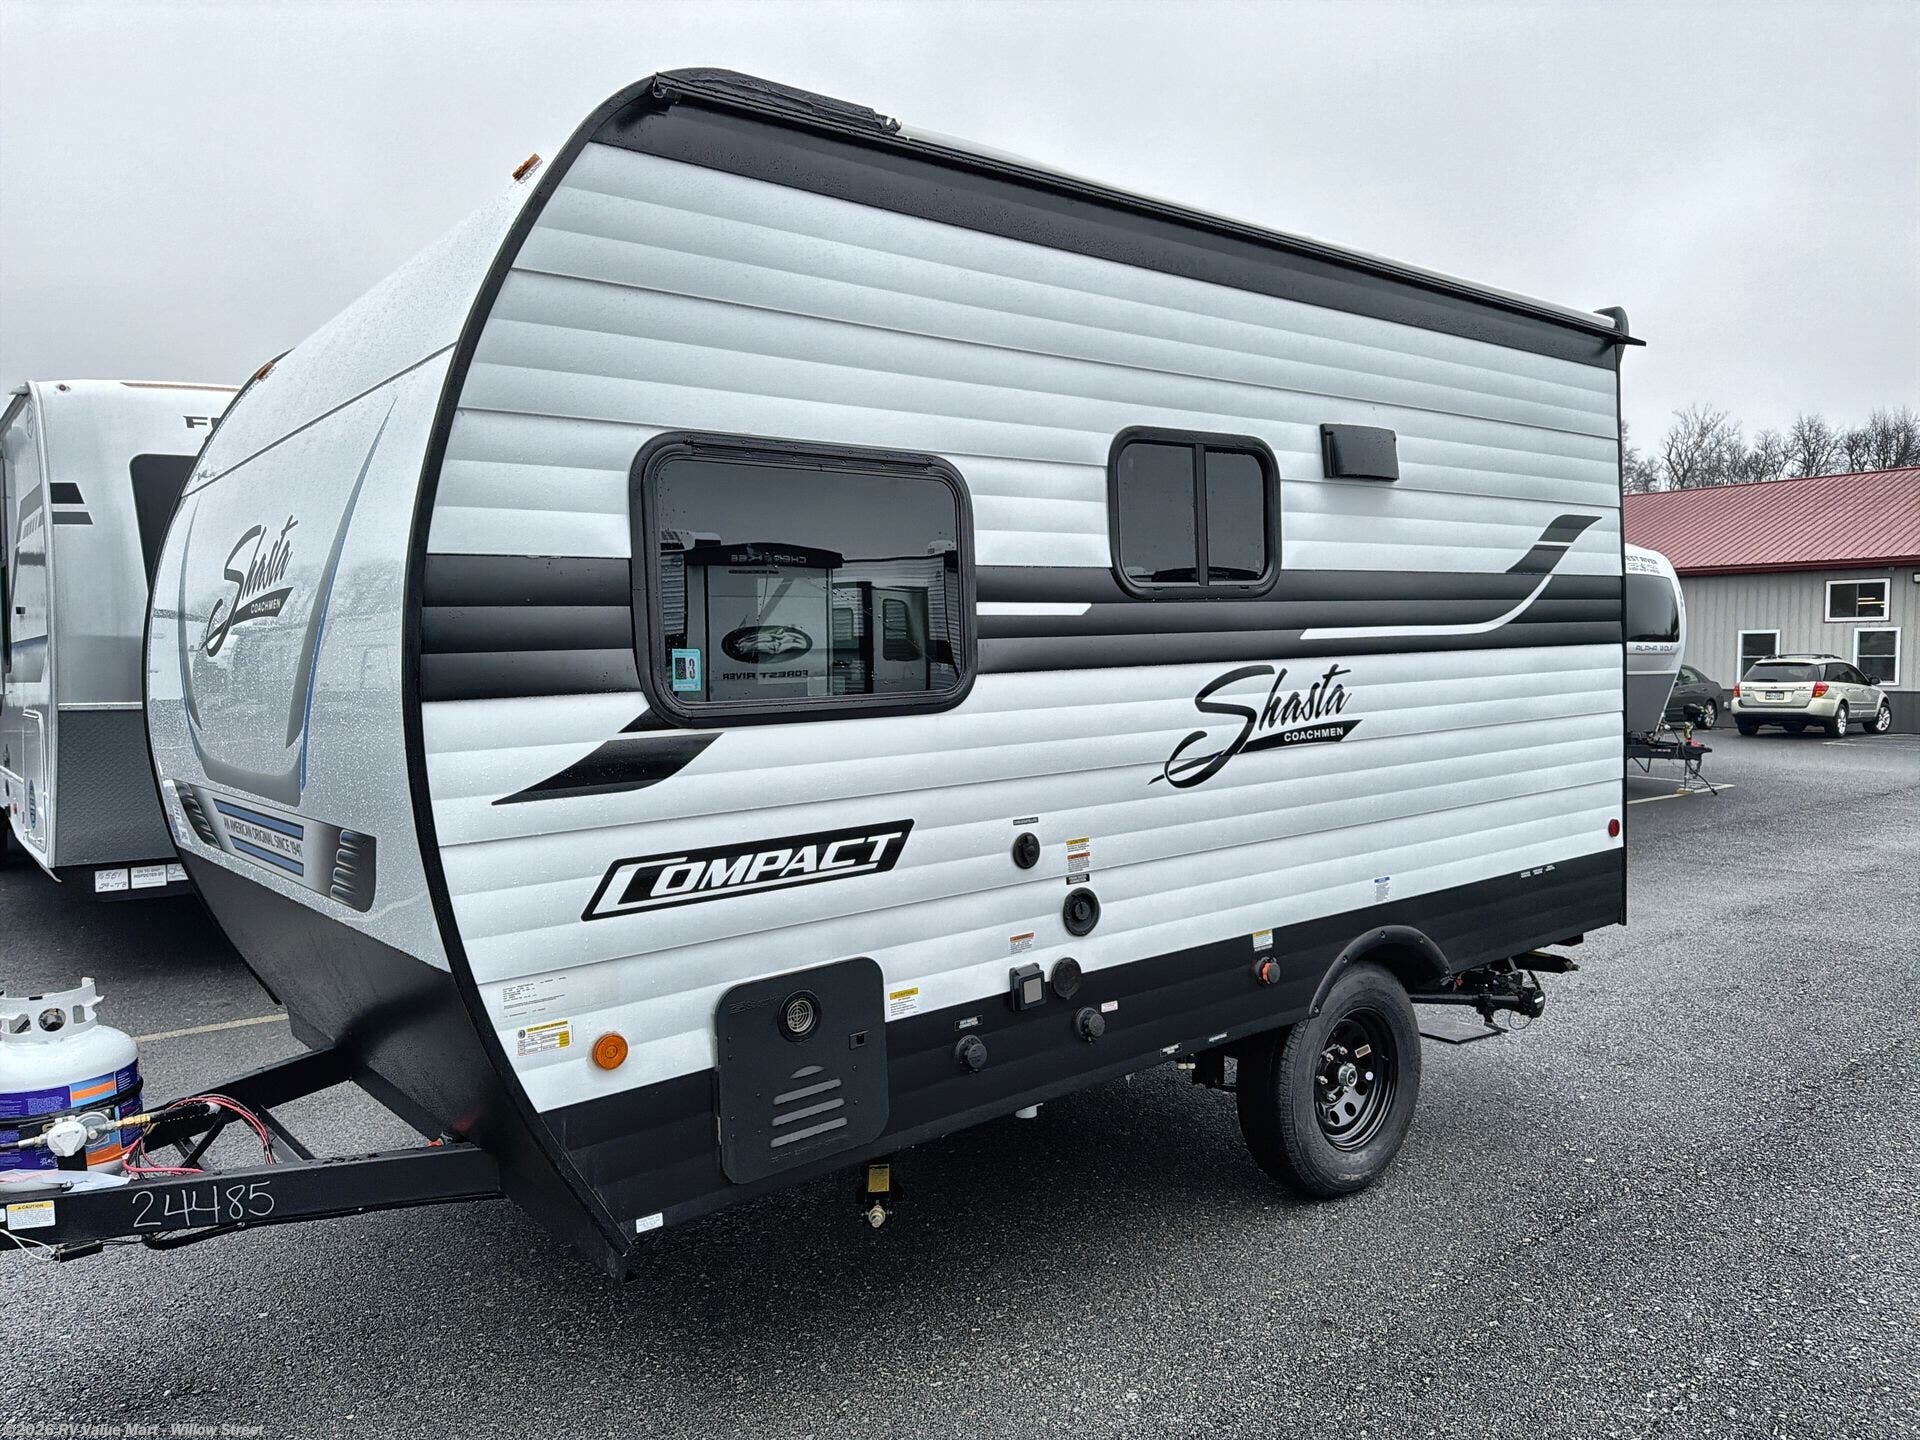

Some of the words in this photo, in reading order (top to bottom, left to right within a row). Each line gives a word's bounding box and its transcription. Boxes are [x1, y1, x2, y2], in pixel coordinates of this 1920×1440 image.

[204, 514, 299, 658] Shasta
[250, 598, 282, 614] COACHMEN
[1163, 664, 1353, 789] Shasta
[1283, 726, 1345, 743] COACHMEN
[230, 819, 253, 839] AMERICAN
[252, 826, 275, 848] ORIGINAL
[274, 834, 291, 853] SINCE
[592, 831, 903, 915] COMPACT
[131, 1180, 275, 1228] 24485
